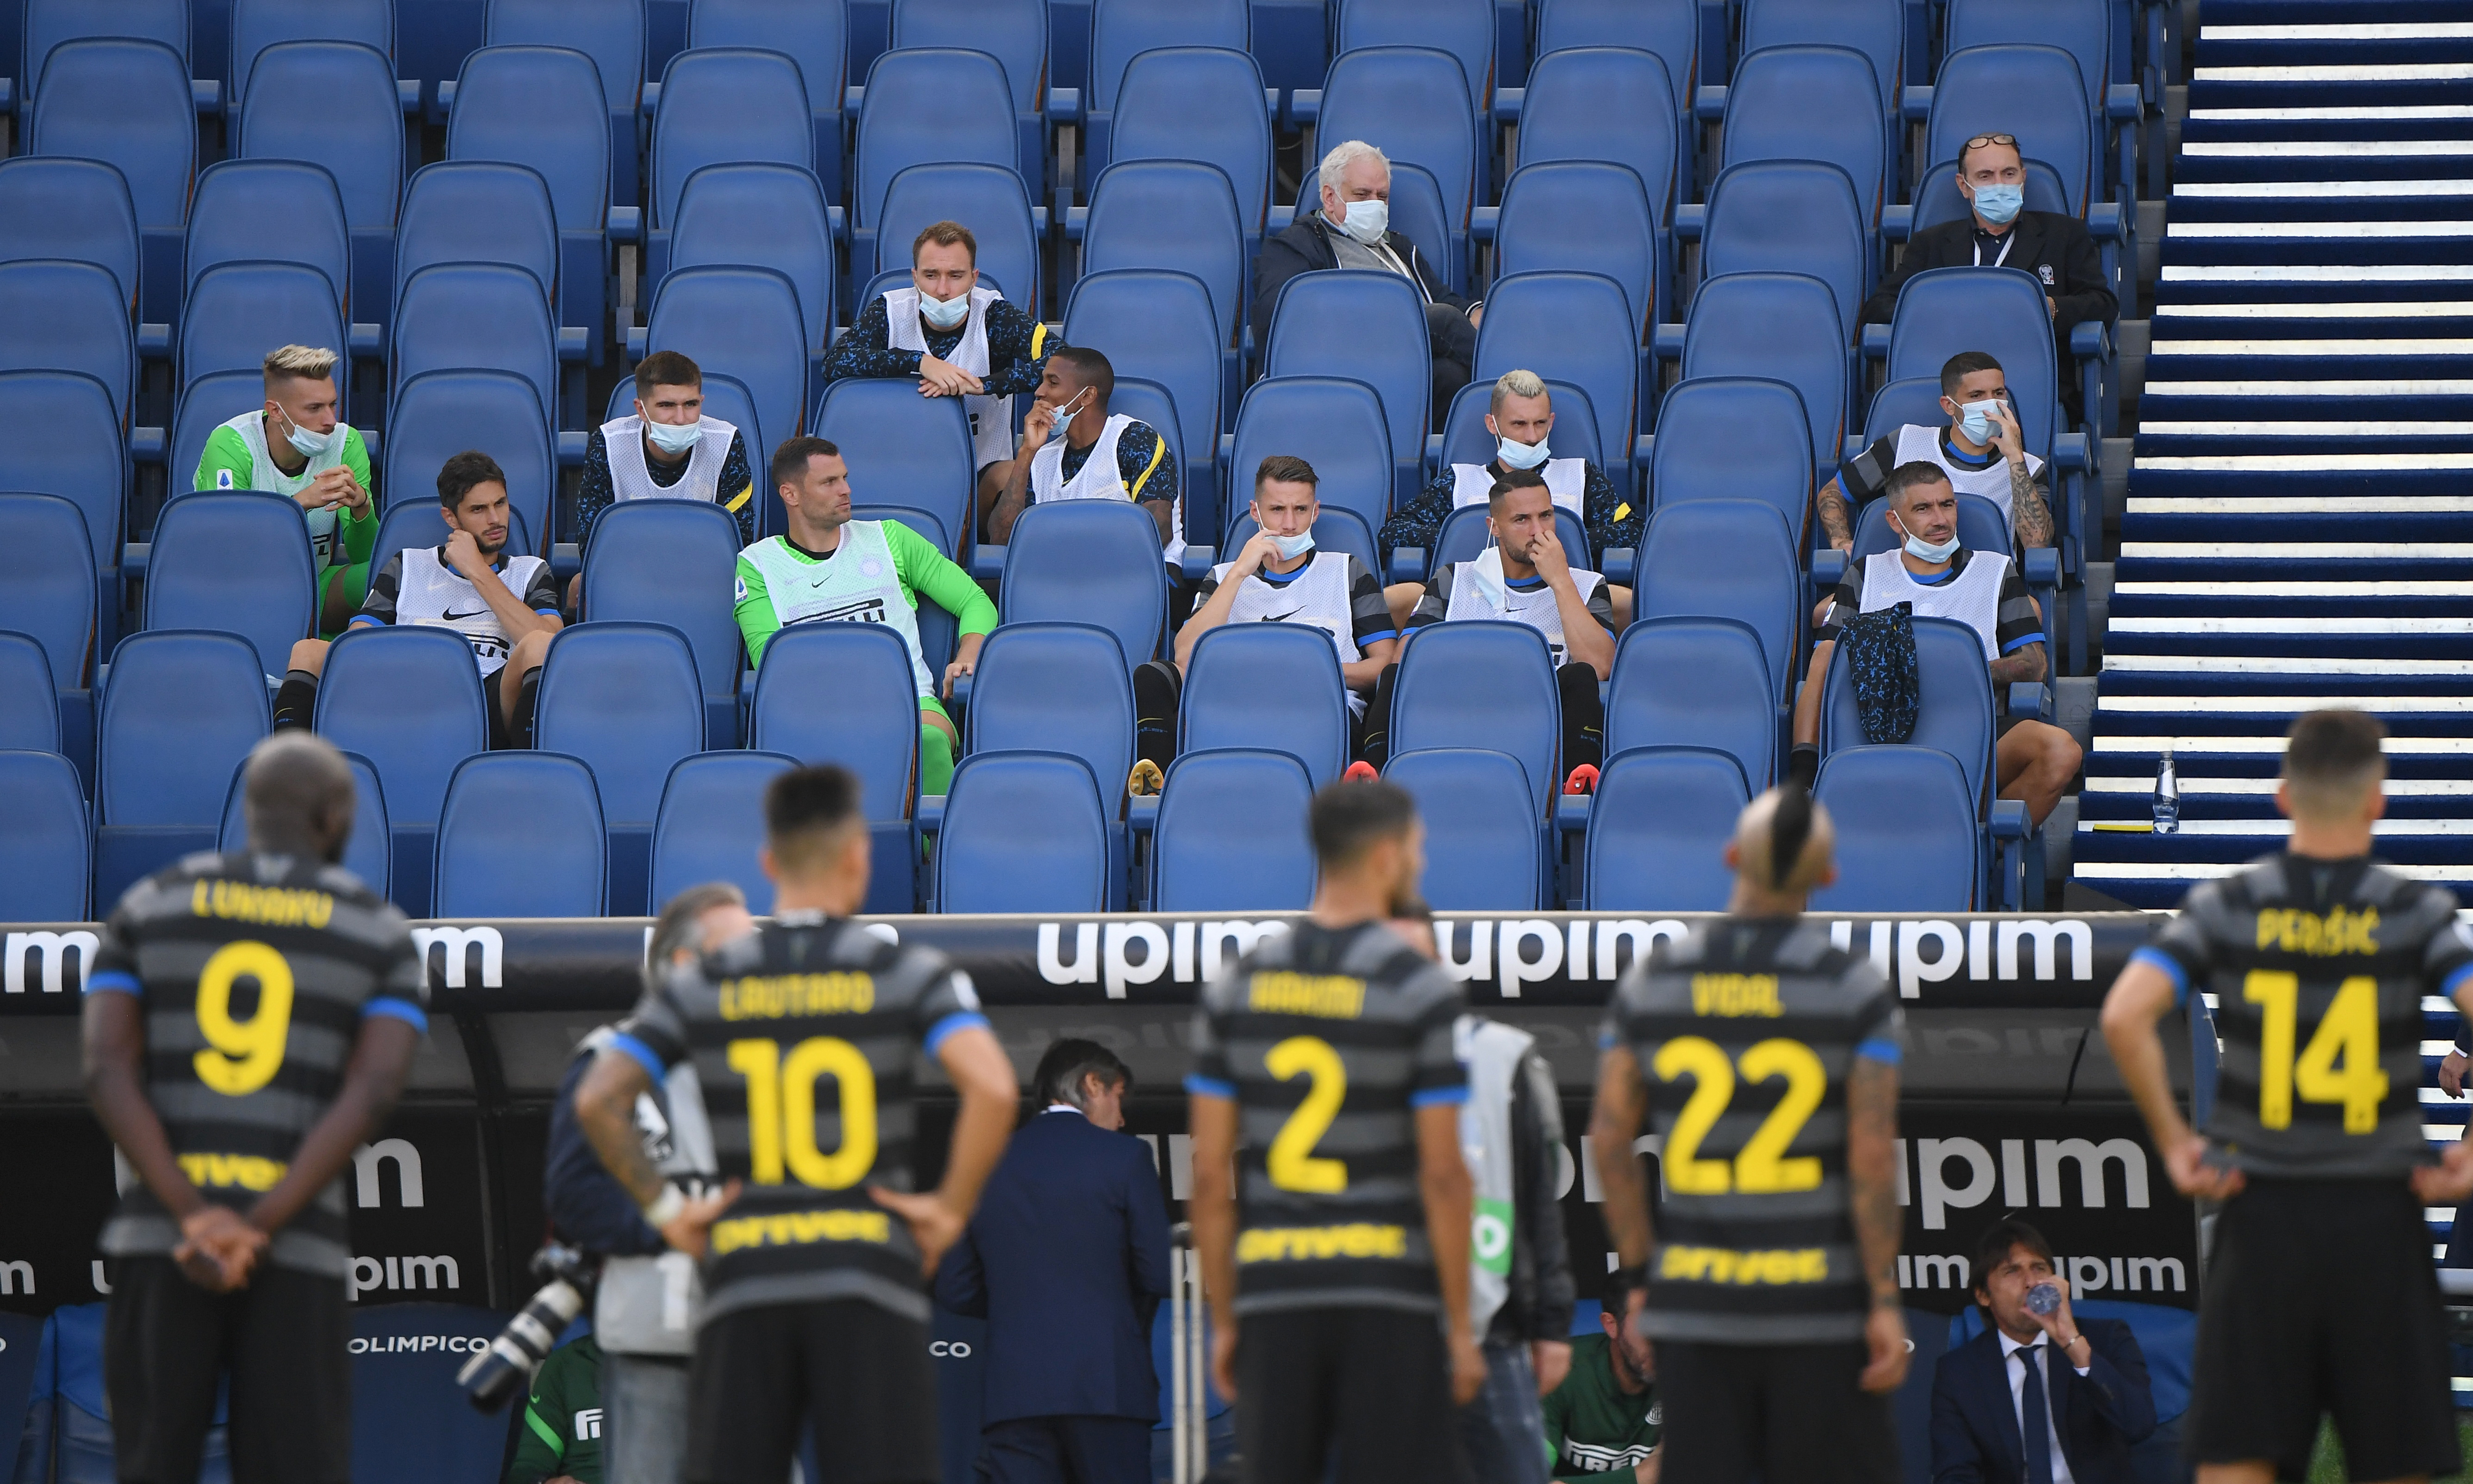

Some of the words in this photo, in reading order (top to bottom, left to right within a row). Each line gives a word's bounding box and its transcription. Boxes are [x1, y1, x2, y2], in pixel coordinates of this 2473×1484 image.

[1037, 920, 1291, 999] upim
[1433, 919, 1688, 998] upim
[192, 940, 295, 1096] 9
[2243, 969, 2389, 1136] 14
[727, 1035, 878, 1191] 10
[1265, 1034, 1348, 1194] 2
[1653, 1035, 1827, 1195] 22
[1893, 1136, 2150, 1230] pim
[345, 1255, 460, 1301] pim
[1896, 1255, 1969, 1289] im
[347, 1335, 489, 1354] OLIMPICO
